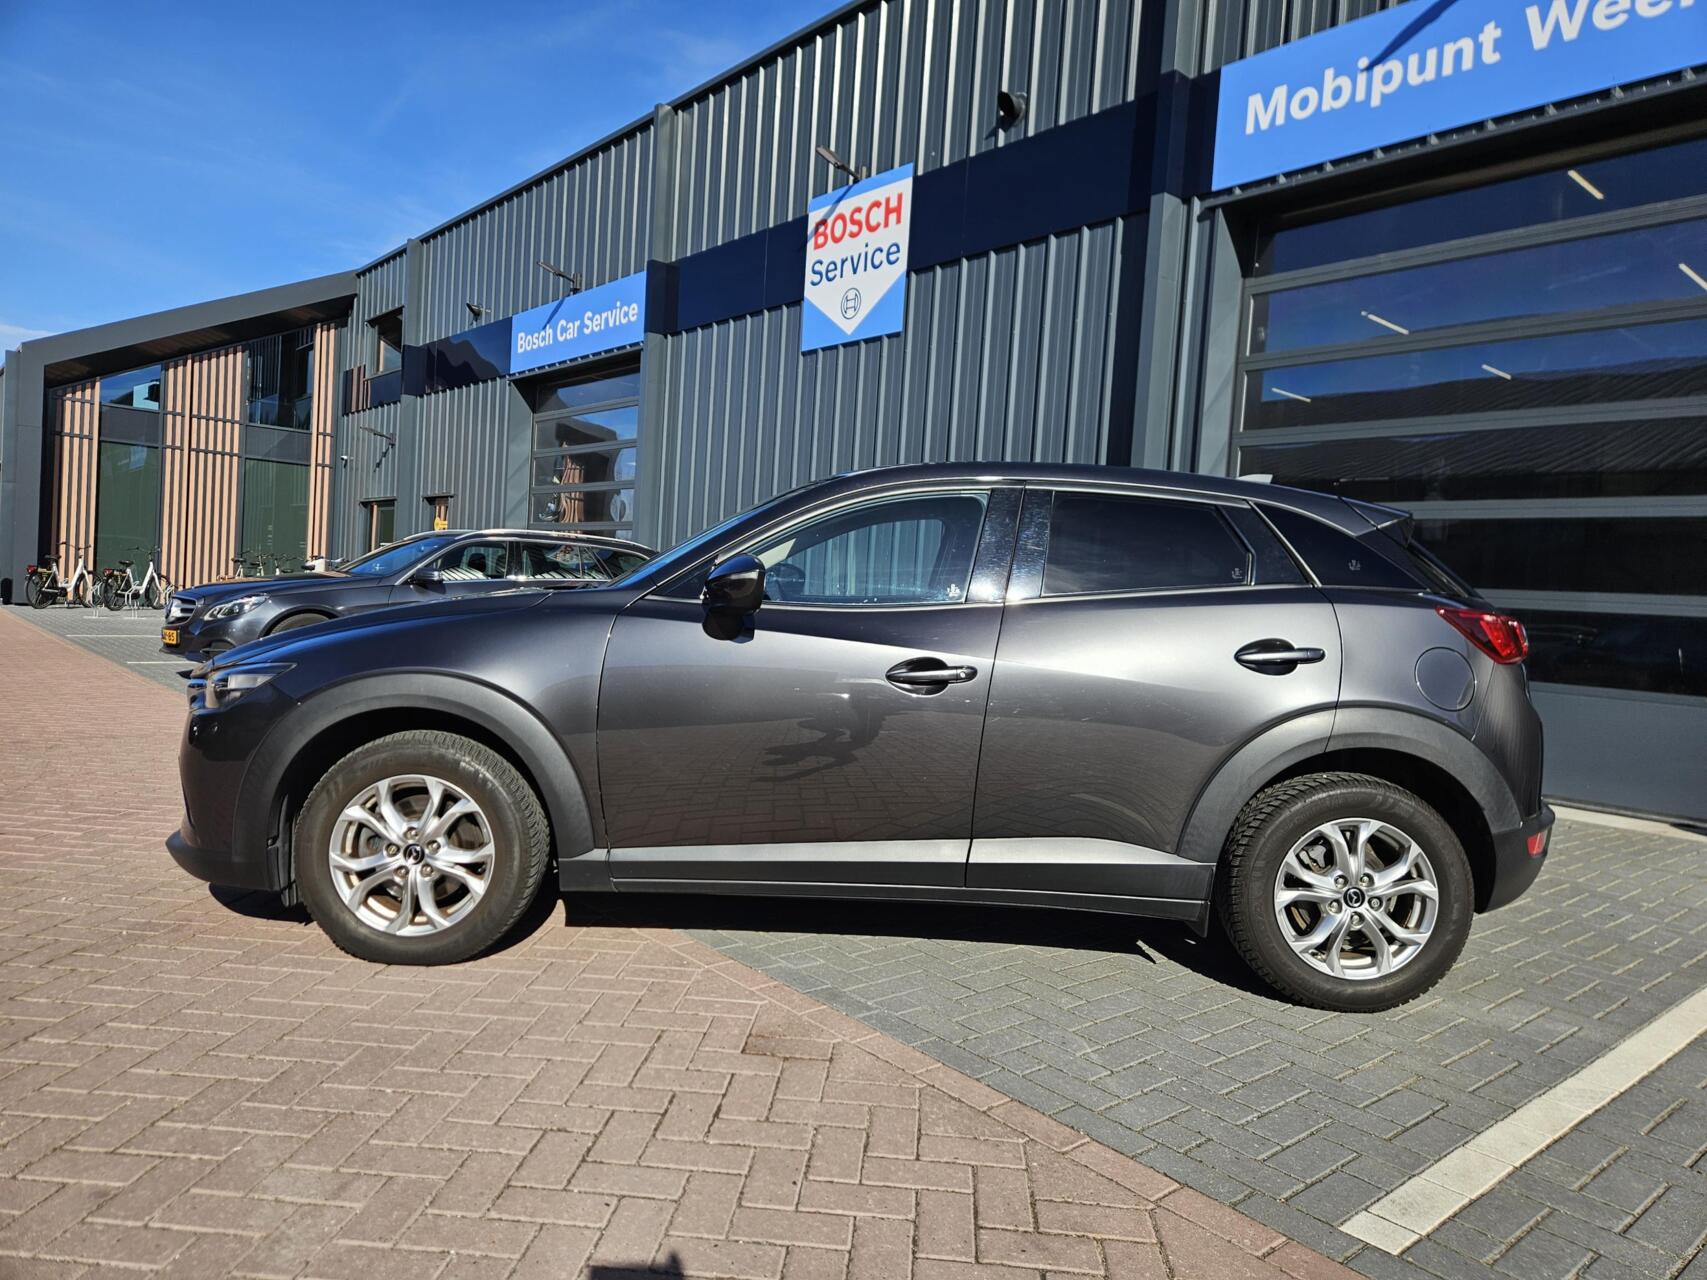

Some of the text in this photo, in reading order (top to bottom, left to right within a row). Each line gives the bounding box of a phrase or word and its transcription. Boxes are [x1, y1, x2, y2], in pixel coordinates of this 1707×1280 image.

[1244, 0, 1695, 135] Mobipunt We
[813, 192, 903, 250] BOSCH
[809, 241, 901, 287] Service
[517, 301, 639, 353] Bosch Car Service
